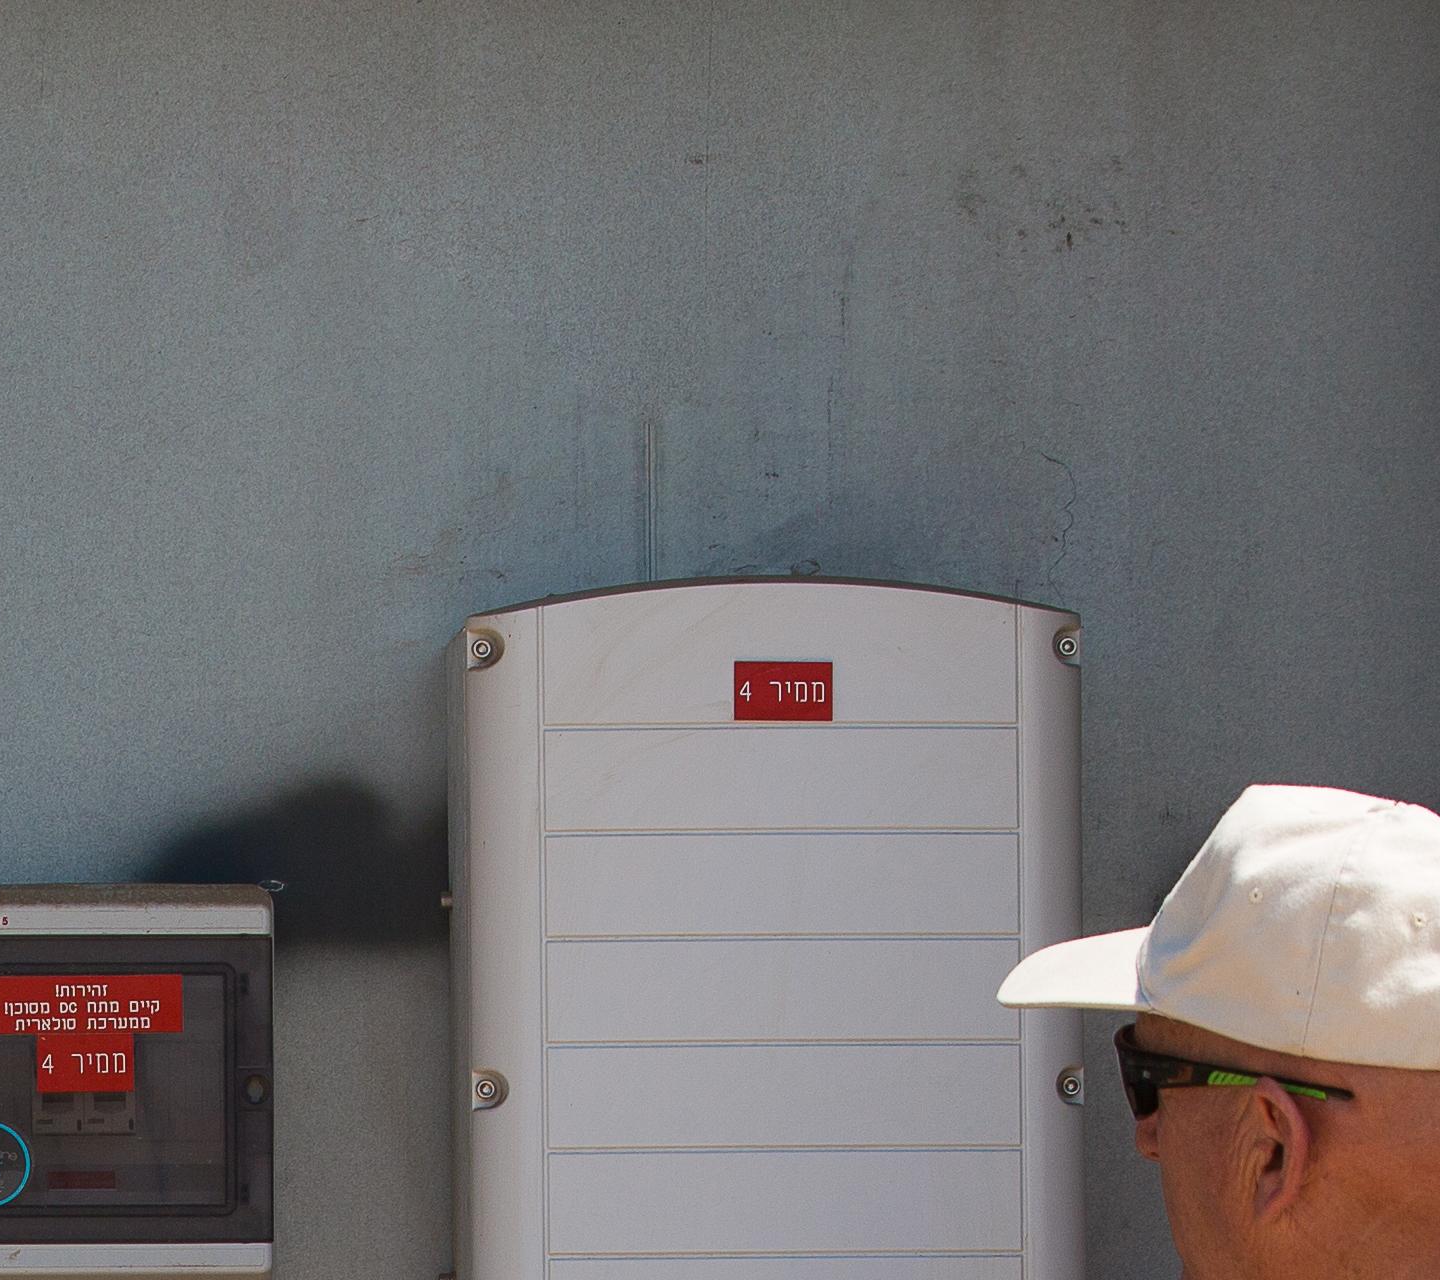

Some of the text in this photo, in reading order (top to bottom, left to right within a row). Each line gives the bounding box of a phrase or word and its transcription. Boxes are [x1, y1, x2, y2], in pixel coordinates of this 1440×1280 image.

[739, 681, 825, 703] ממיר 4
[55, 984, 108, 998] זהירות!
[4, 1000, 160, 1015] קיים מתח DC מסוכן!
[15, 1016, 151, 1031] ממערכת סולארית
[41, 1052, 126, 1075] ממיר 4
